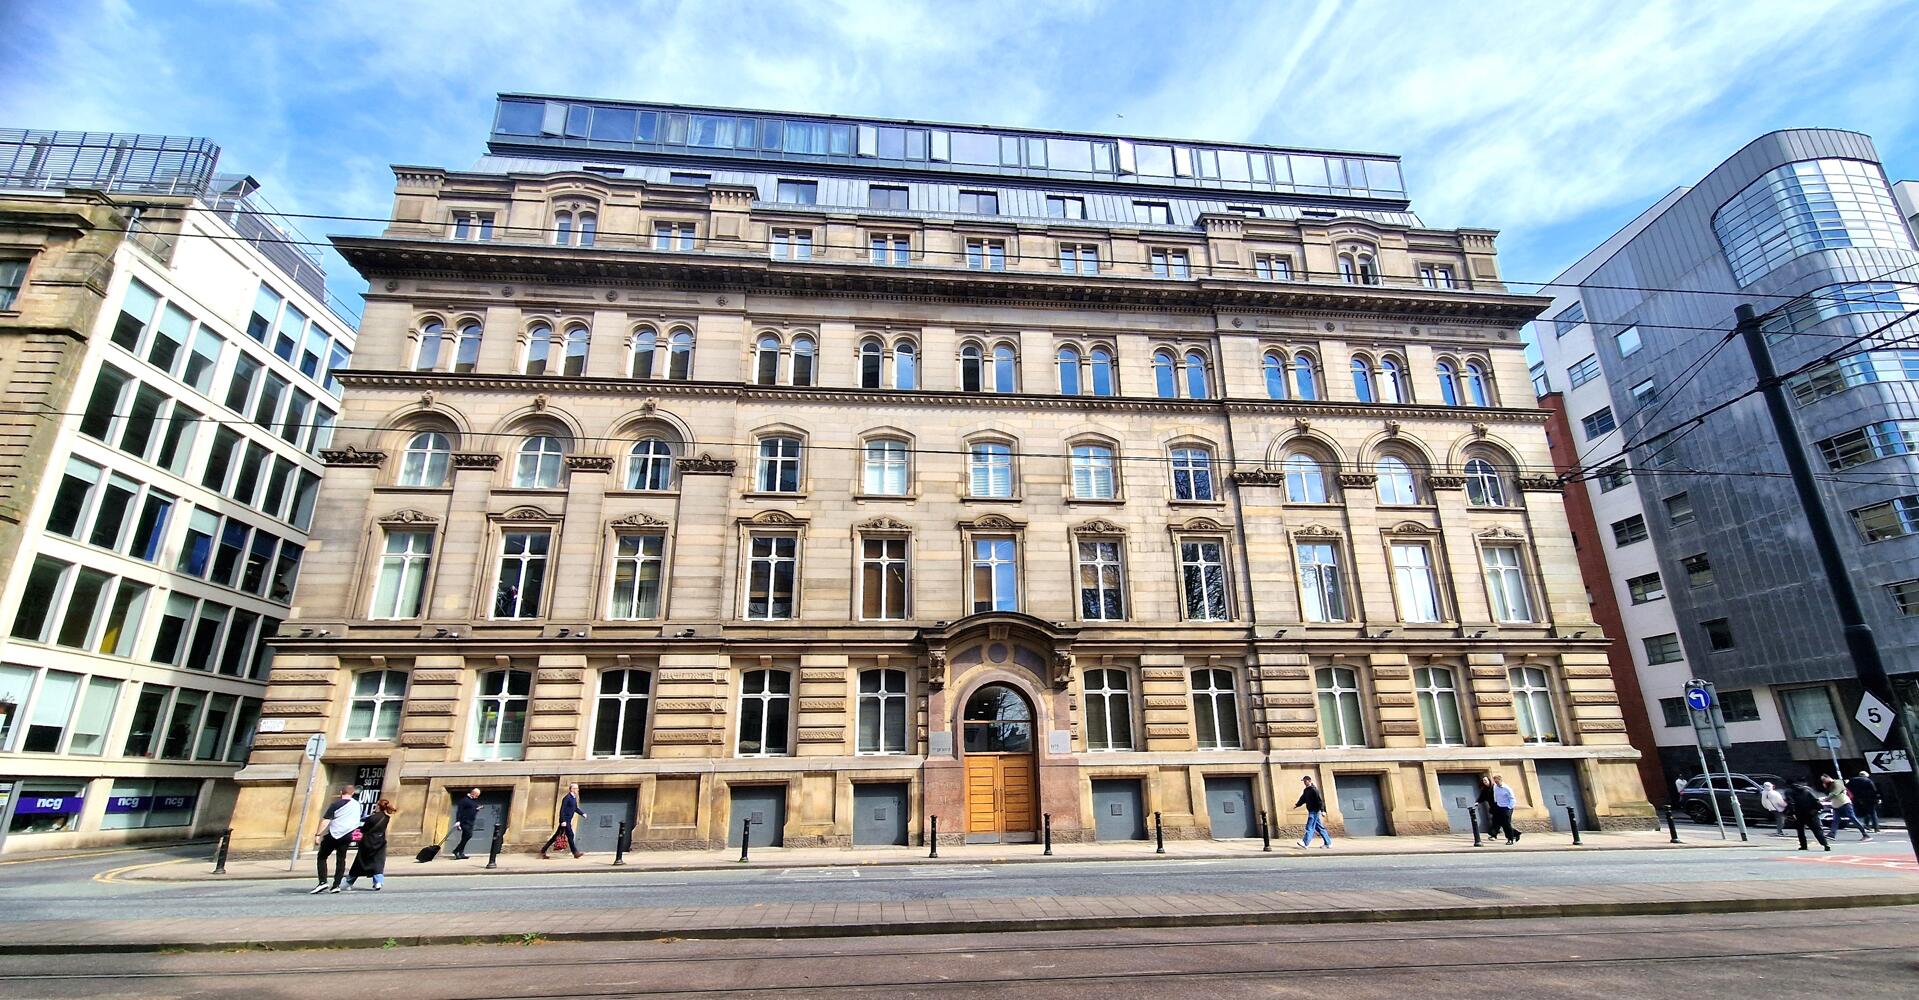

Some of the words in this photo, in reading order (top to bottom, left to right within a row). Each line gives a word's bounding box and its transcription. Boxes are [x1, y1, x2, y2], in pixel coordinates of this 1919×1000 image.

[1867, 707, 1882, 724] 5
[117, 796, 140, 807] ncg
[164, 797, 184, 807] ncg
[359, 789, 380, 803] UNIT
[36, 797, 64, 810] ncg
